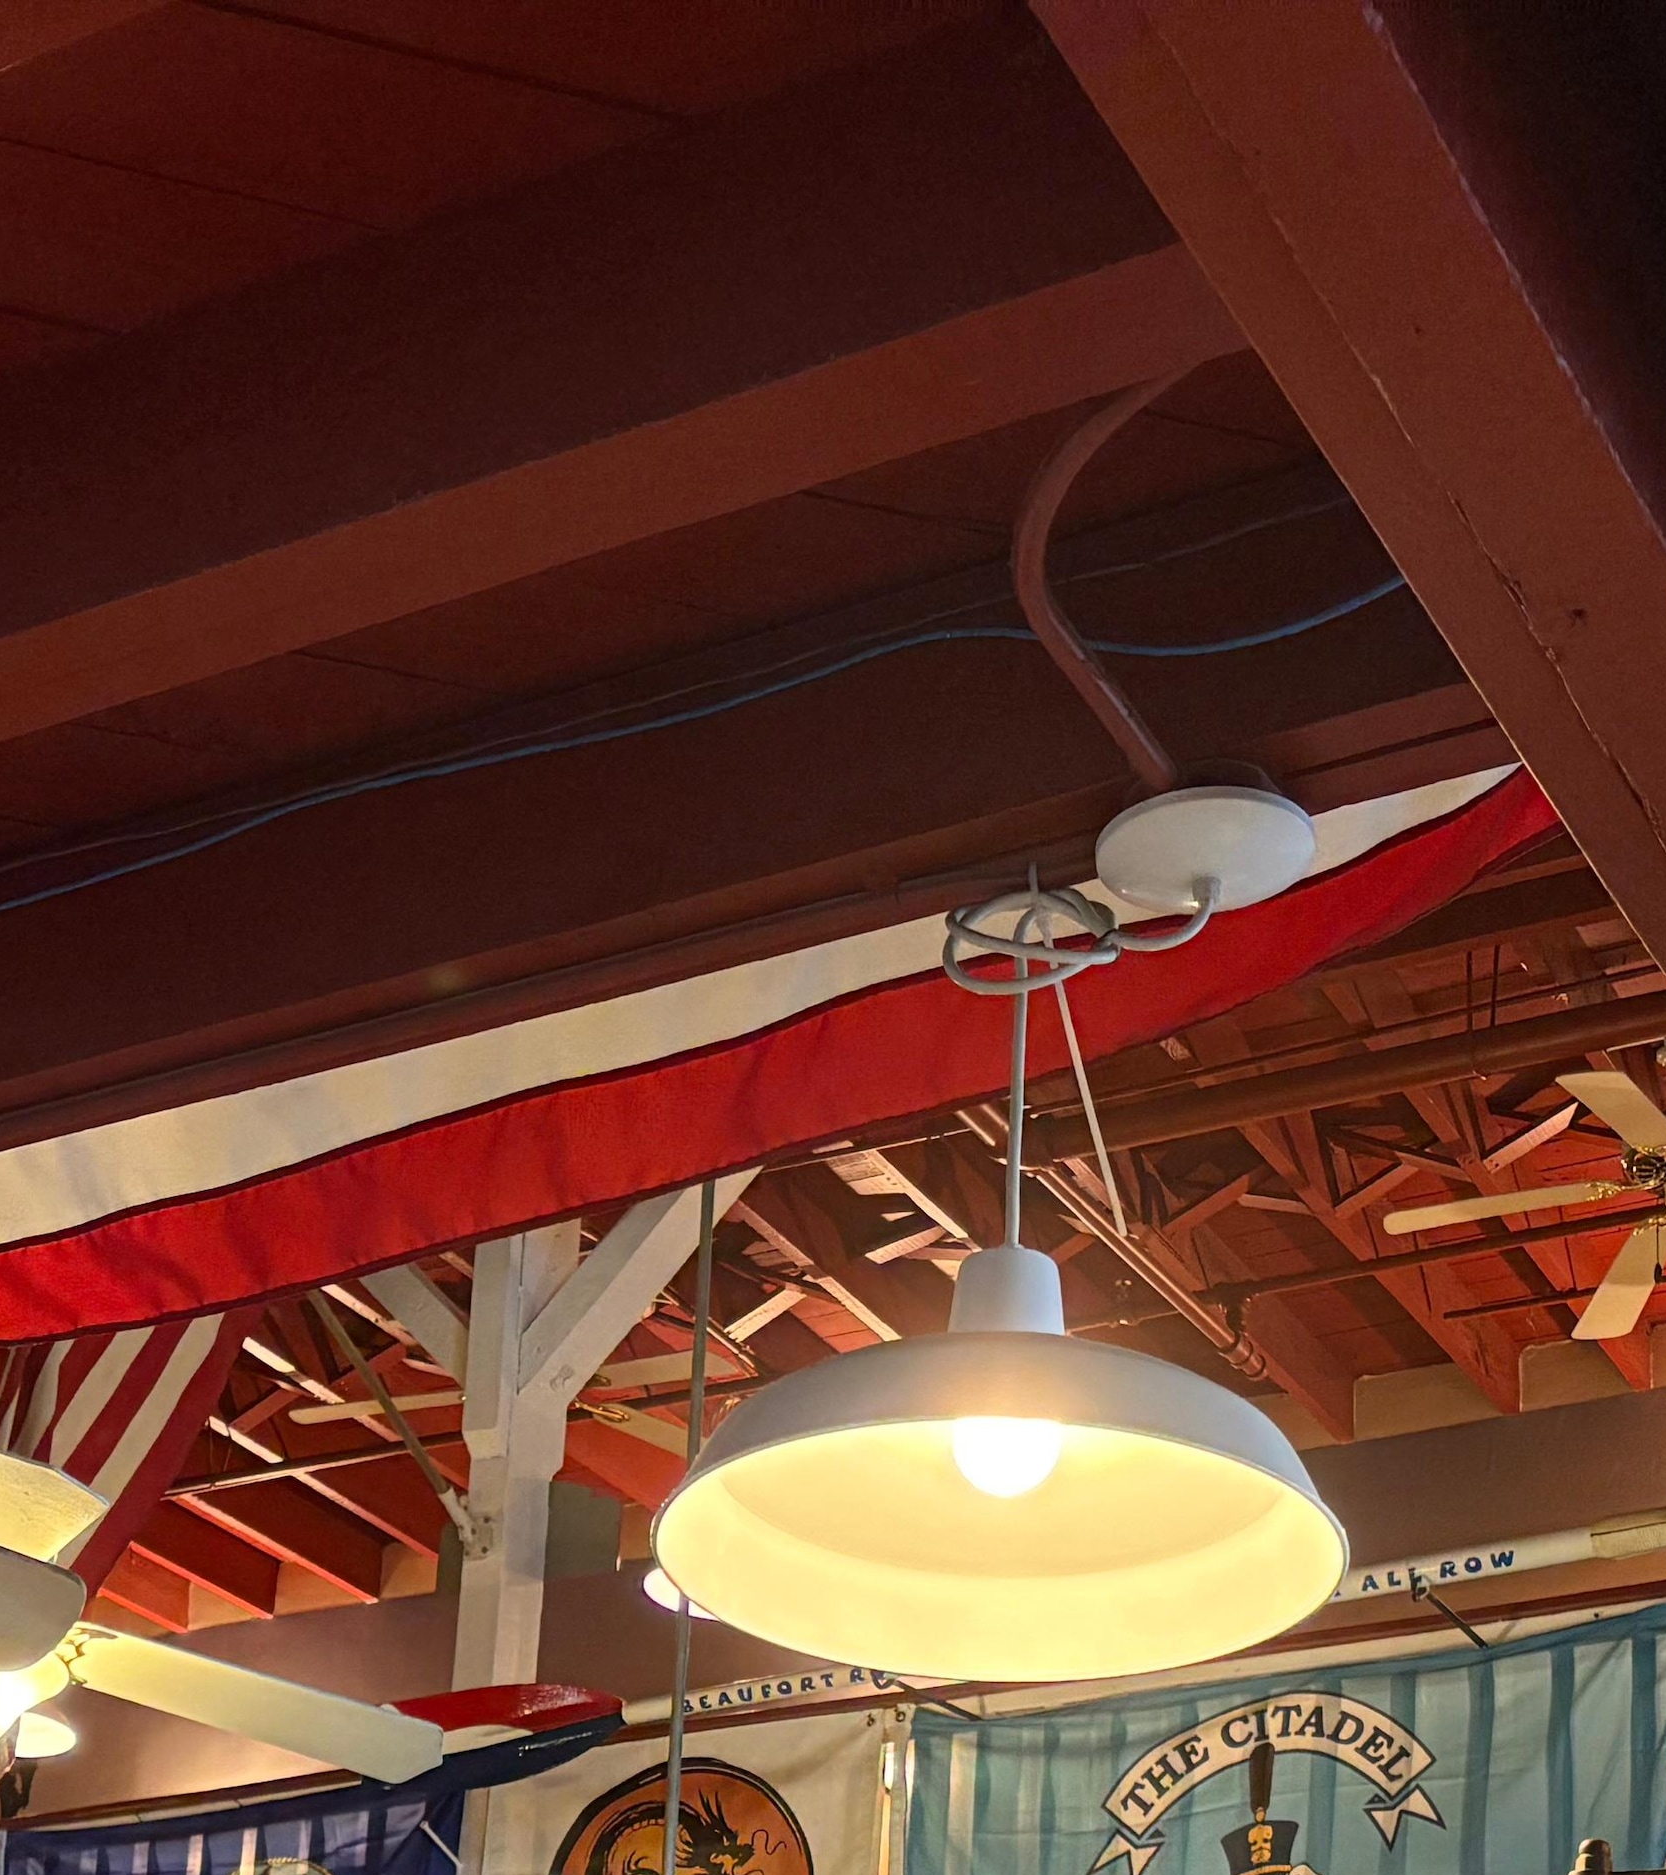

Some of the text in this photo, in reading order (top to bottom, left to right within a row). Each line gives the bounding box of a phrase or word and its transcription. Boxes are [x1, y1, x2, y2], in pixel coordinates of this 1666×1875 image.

[1439, 1550, 1514, 1578] ROW
[684, 1672, 833, 1713] BEAUFORT
[1120, 1703, 1415, 1818] THE CITADEL
